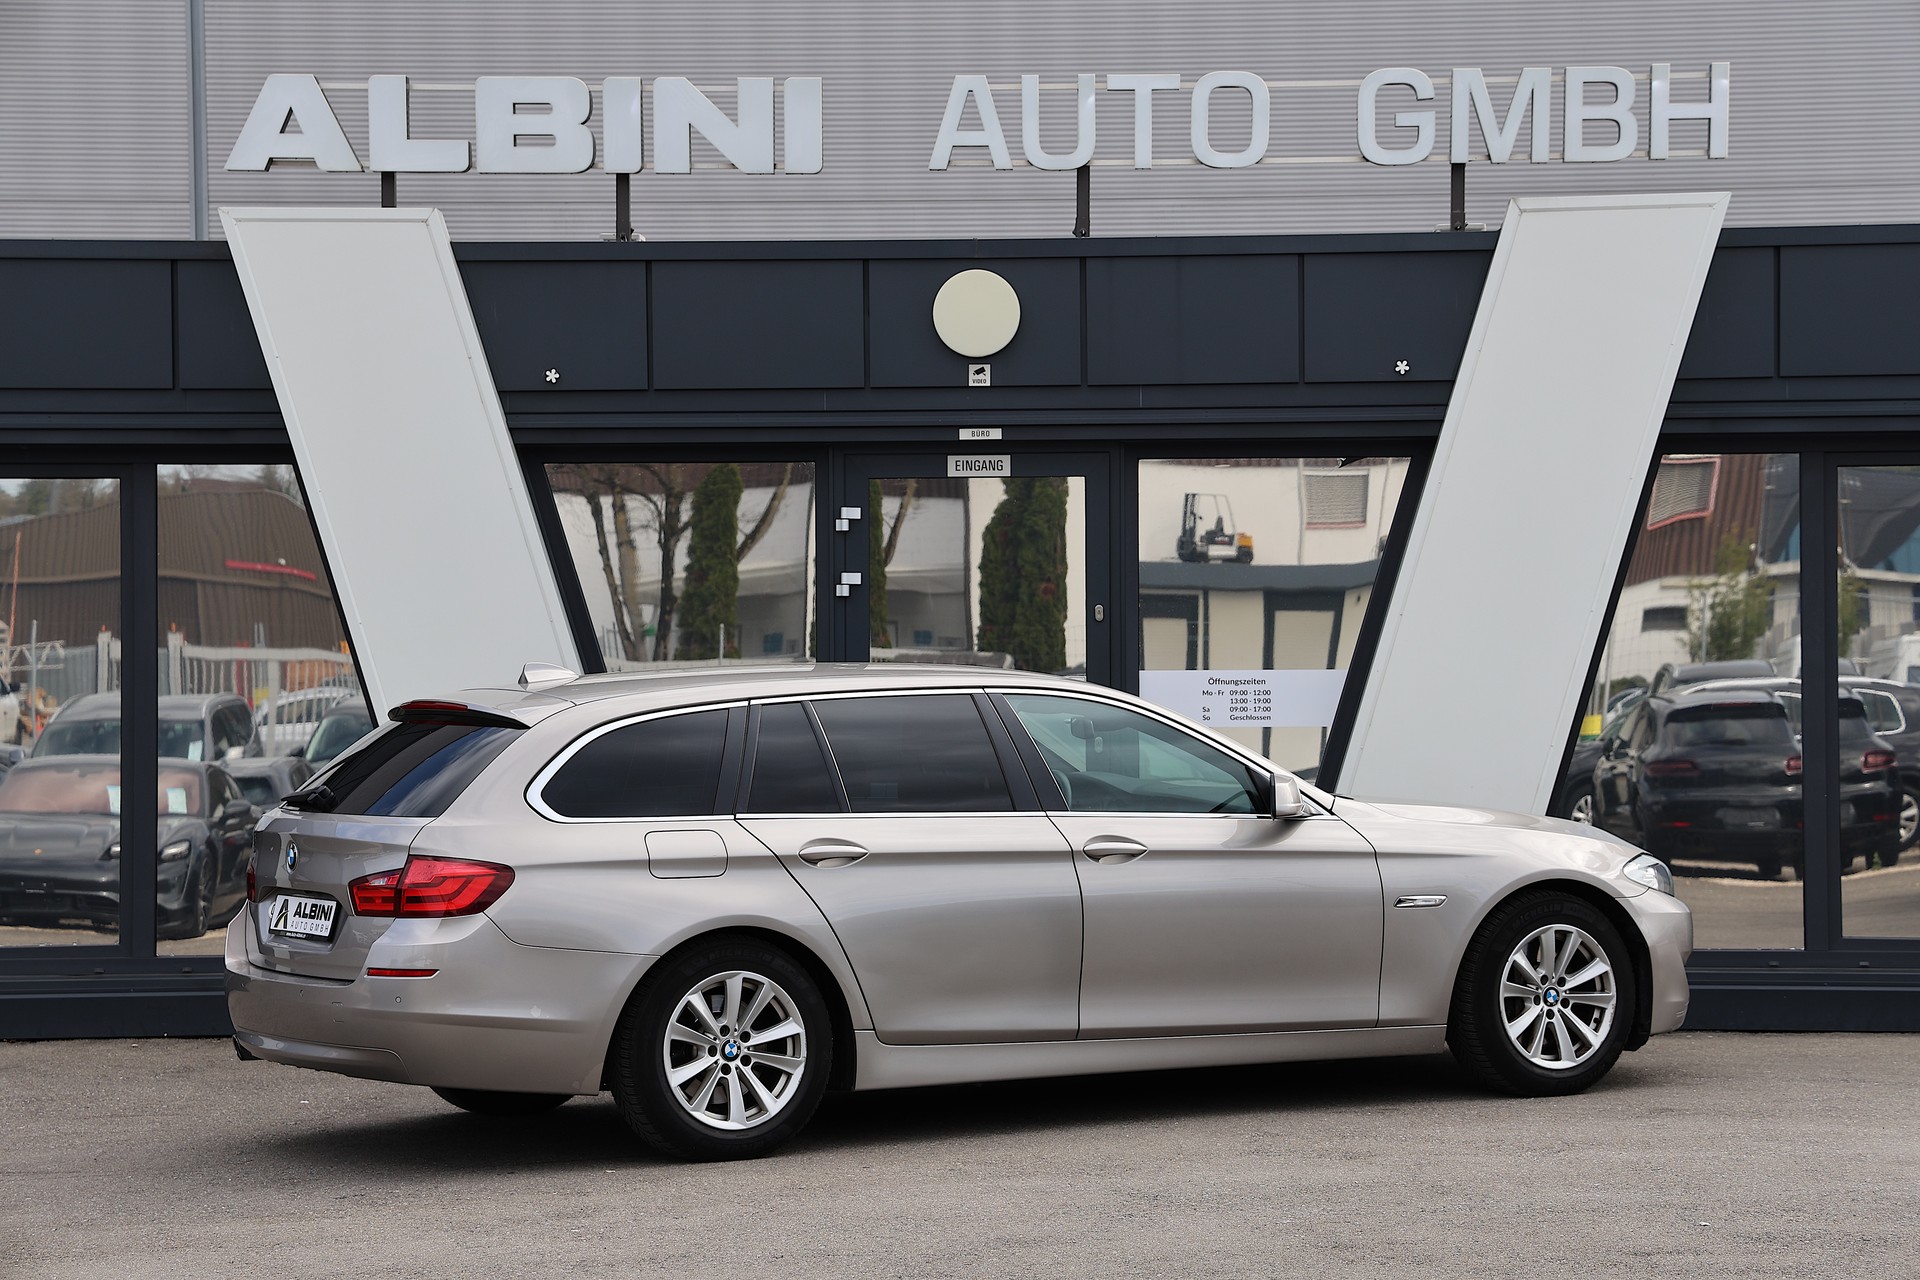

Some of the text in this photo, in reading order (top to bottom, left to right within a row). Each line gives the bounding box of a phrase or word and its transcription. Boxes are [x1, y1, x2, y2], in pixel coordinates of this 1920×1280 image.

[224, 61, 1732, 175] ALBINI AUTO GMBH
[971, 429, 991, 437] BÜRO
[955, 459, 1004, 472] EINGANG
[1208, 677, 1266, 686] Öffnungszeiten
[293, 902, 333, 922] ALBINI
[290, 920, 329, 933] AUTO GMBH
